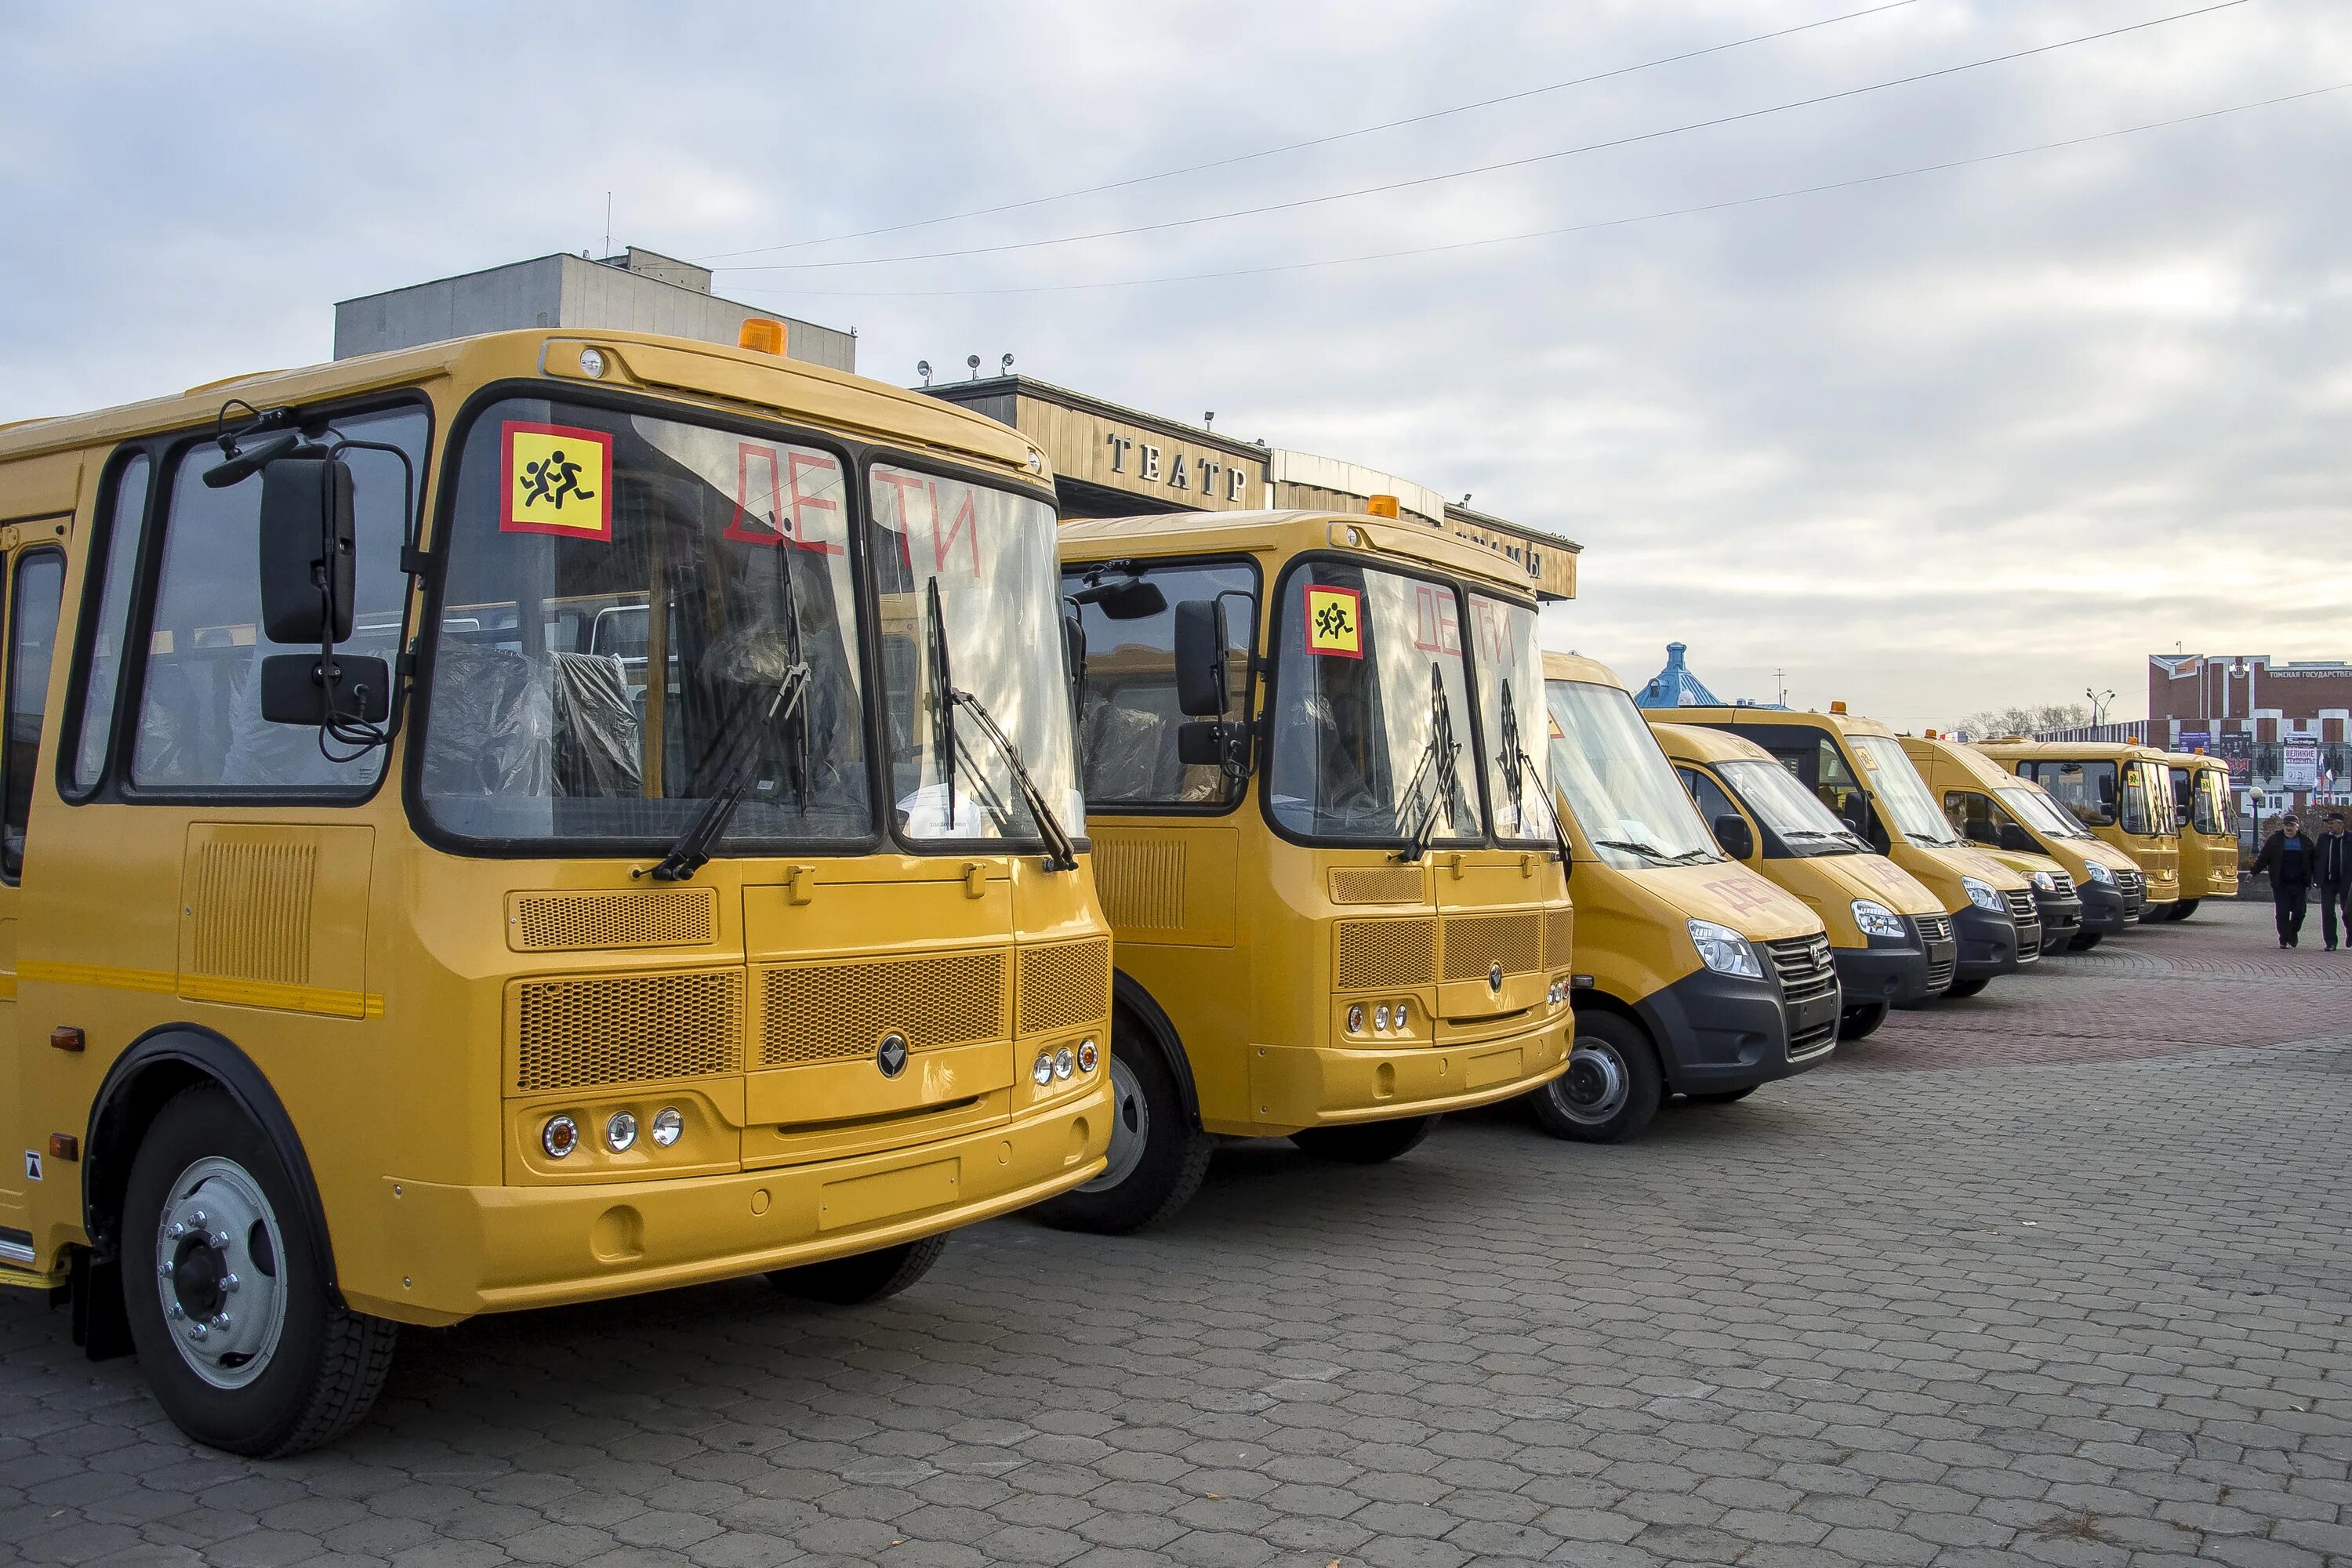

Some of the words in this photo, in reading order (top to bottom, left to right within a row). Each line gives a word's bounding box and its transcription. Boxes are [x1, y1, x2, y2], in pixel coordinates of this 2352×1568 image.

[1107, 433, 1247, 502] ТЕАТР
[723, 442, 981, 579] ДЕТИ
[1414, 586, 1515, 667] ДЕТИ
